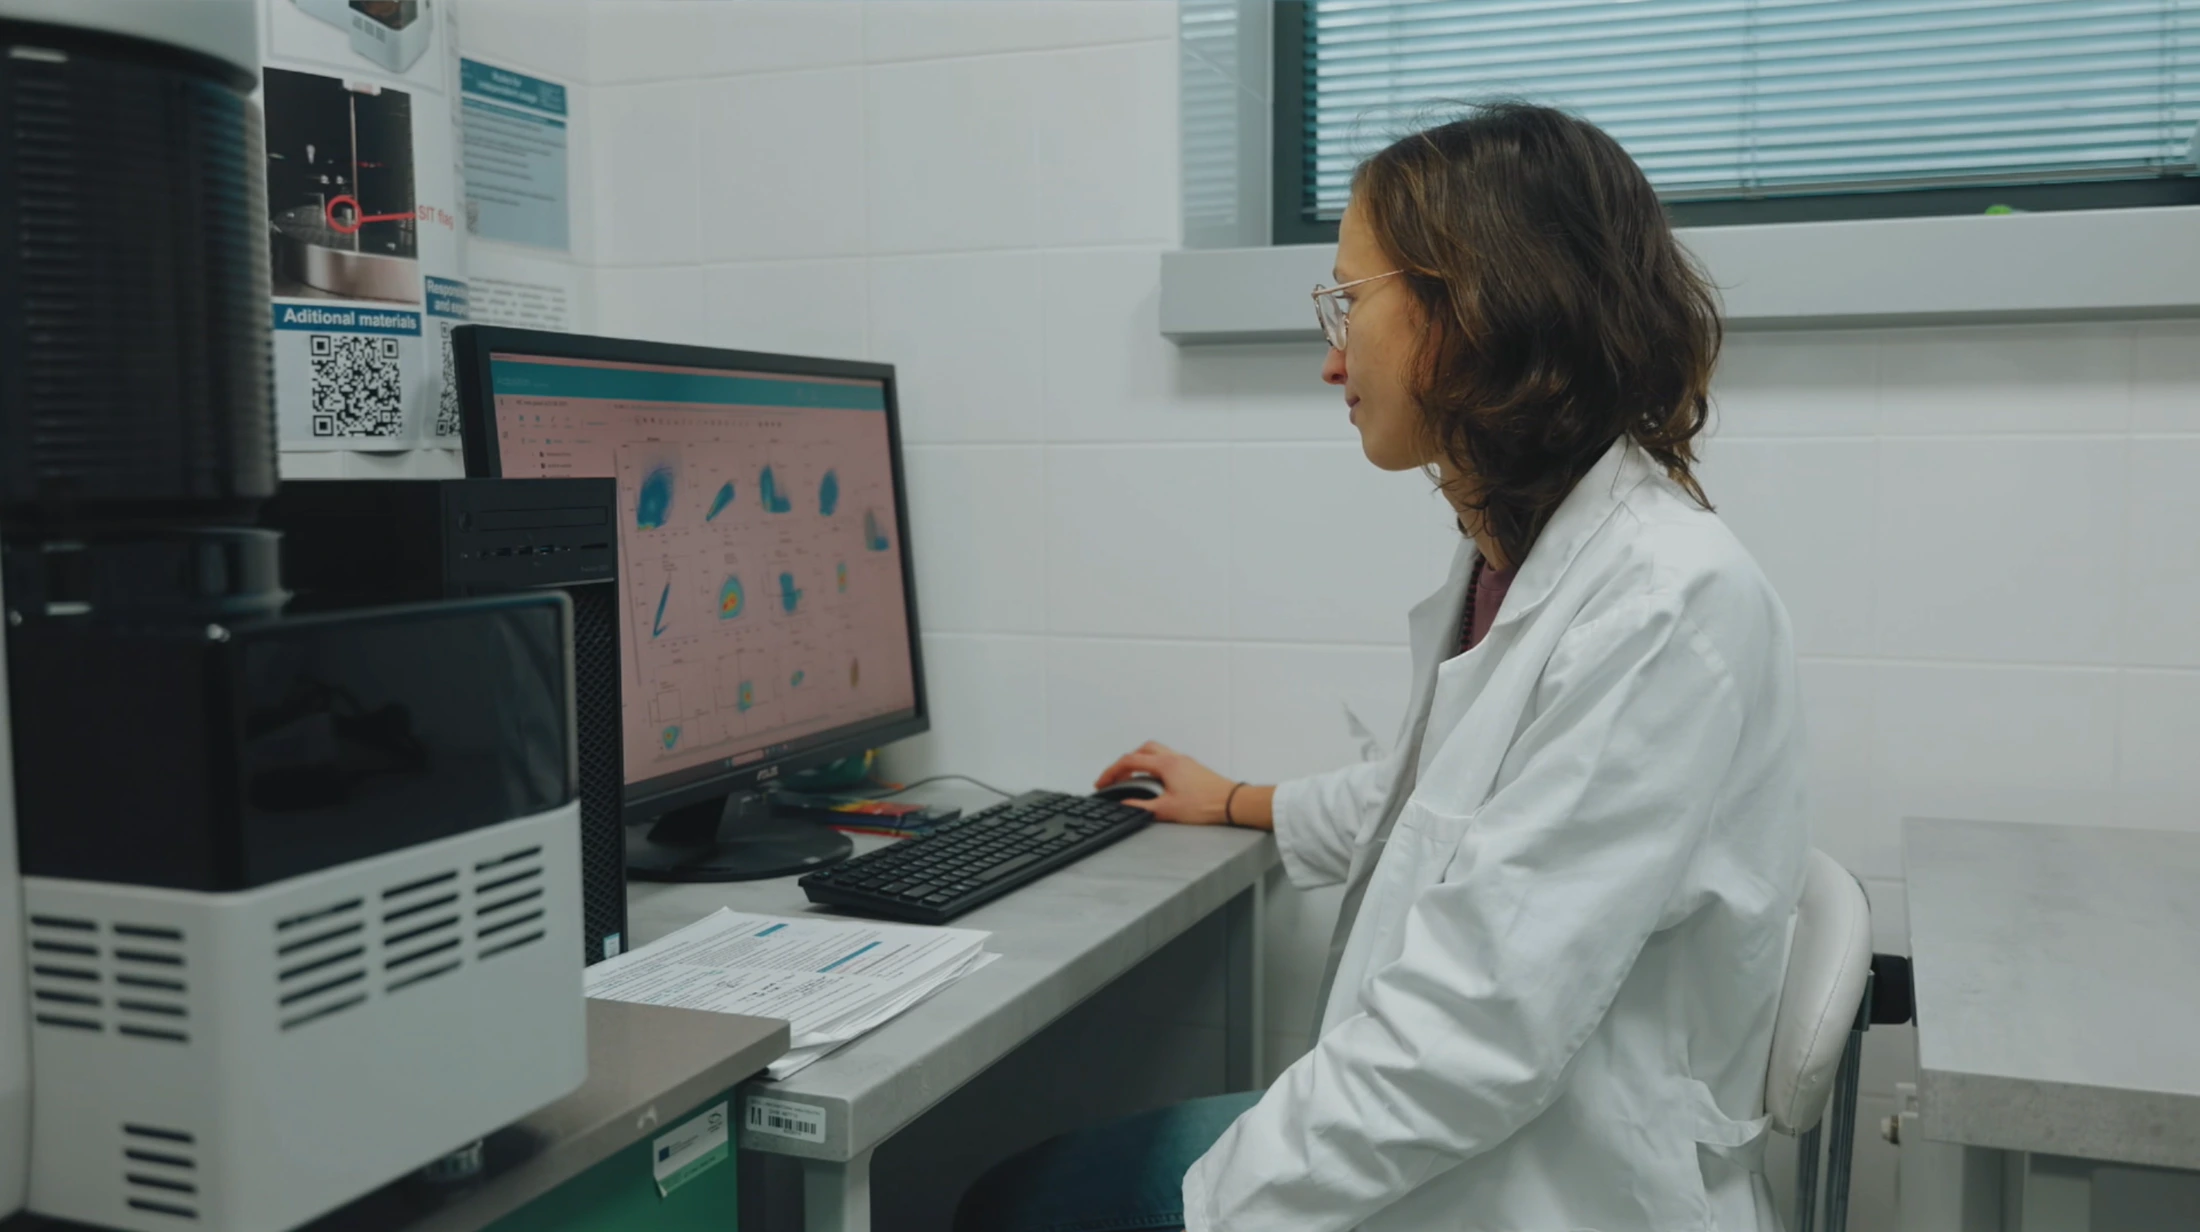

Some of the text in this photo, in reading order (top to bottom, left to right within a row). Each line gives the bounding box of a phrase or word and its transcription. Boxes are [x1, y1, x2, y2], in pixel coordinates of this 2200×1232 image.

[418, 205, 454, 231] SIT flag
[284, 307, 417, 329] Aditional materials
